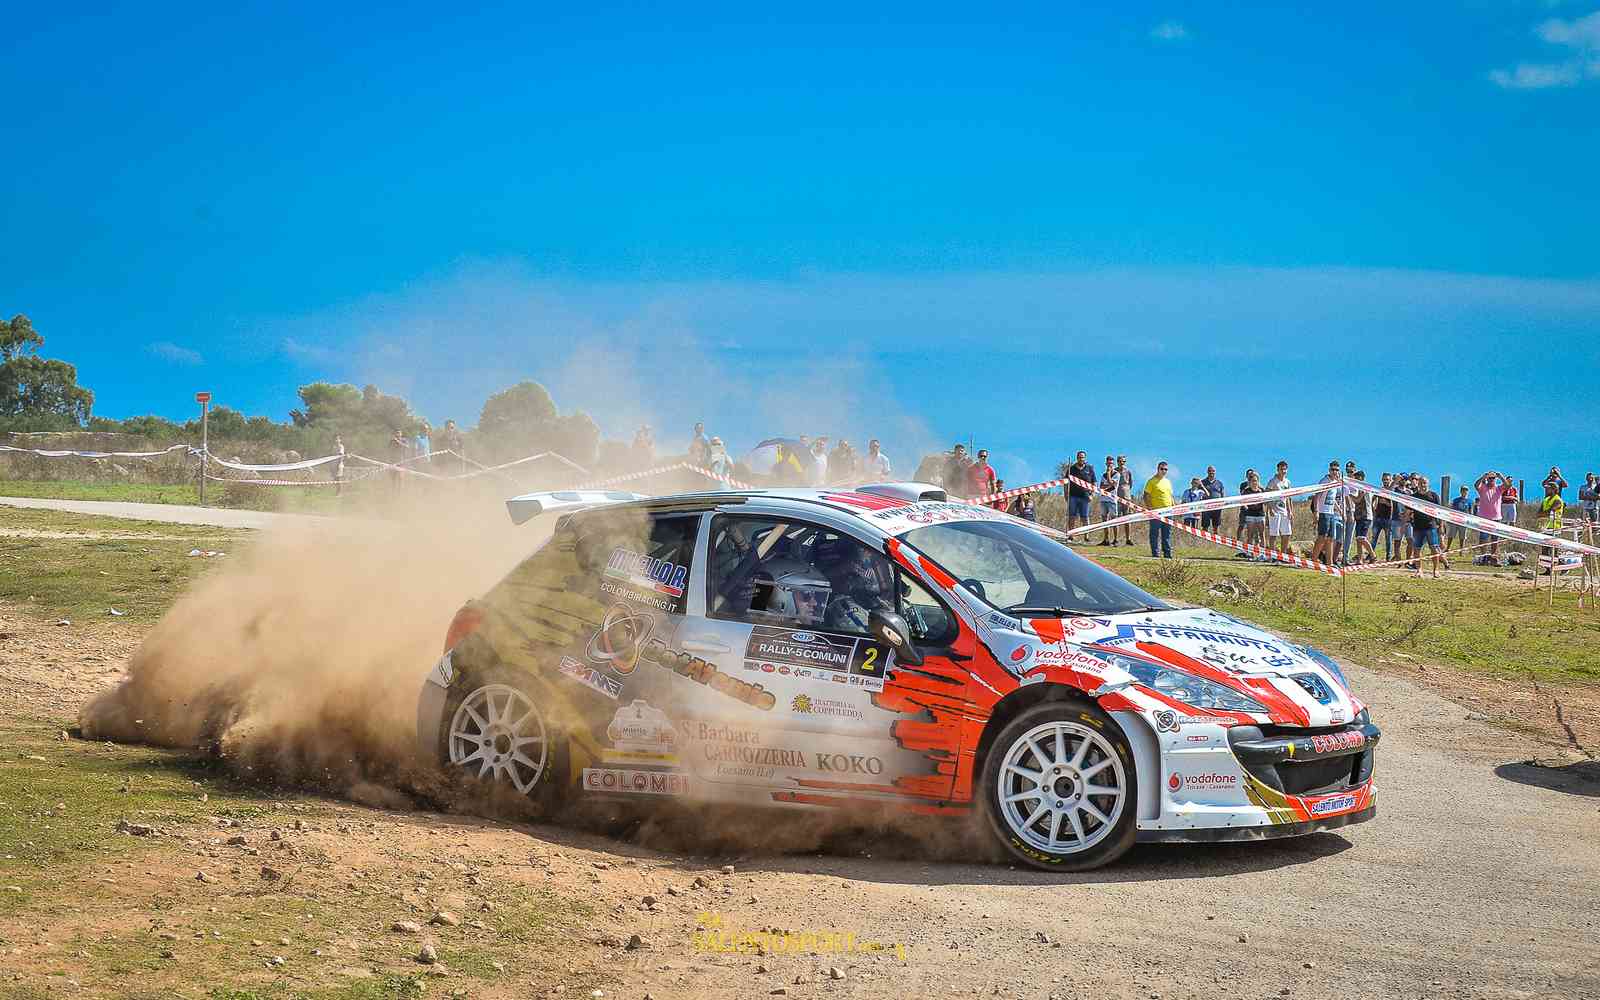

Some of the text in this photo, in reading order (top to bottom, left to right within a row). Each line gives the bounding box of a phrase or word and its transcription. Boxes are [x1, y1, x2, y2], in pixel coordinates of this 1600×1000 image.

[862, 647, 878, 671] 2
[1036, 649, 1108, 670] vodafone
[699, 720, 760, 744] Barbara
[815, 752, 883, 776] KOKO
[586, 772, 689, 793] COLOMBI
[1185, 773, 1236, 784] vodafone
